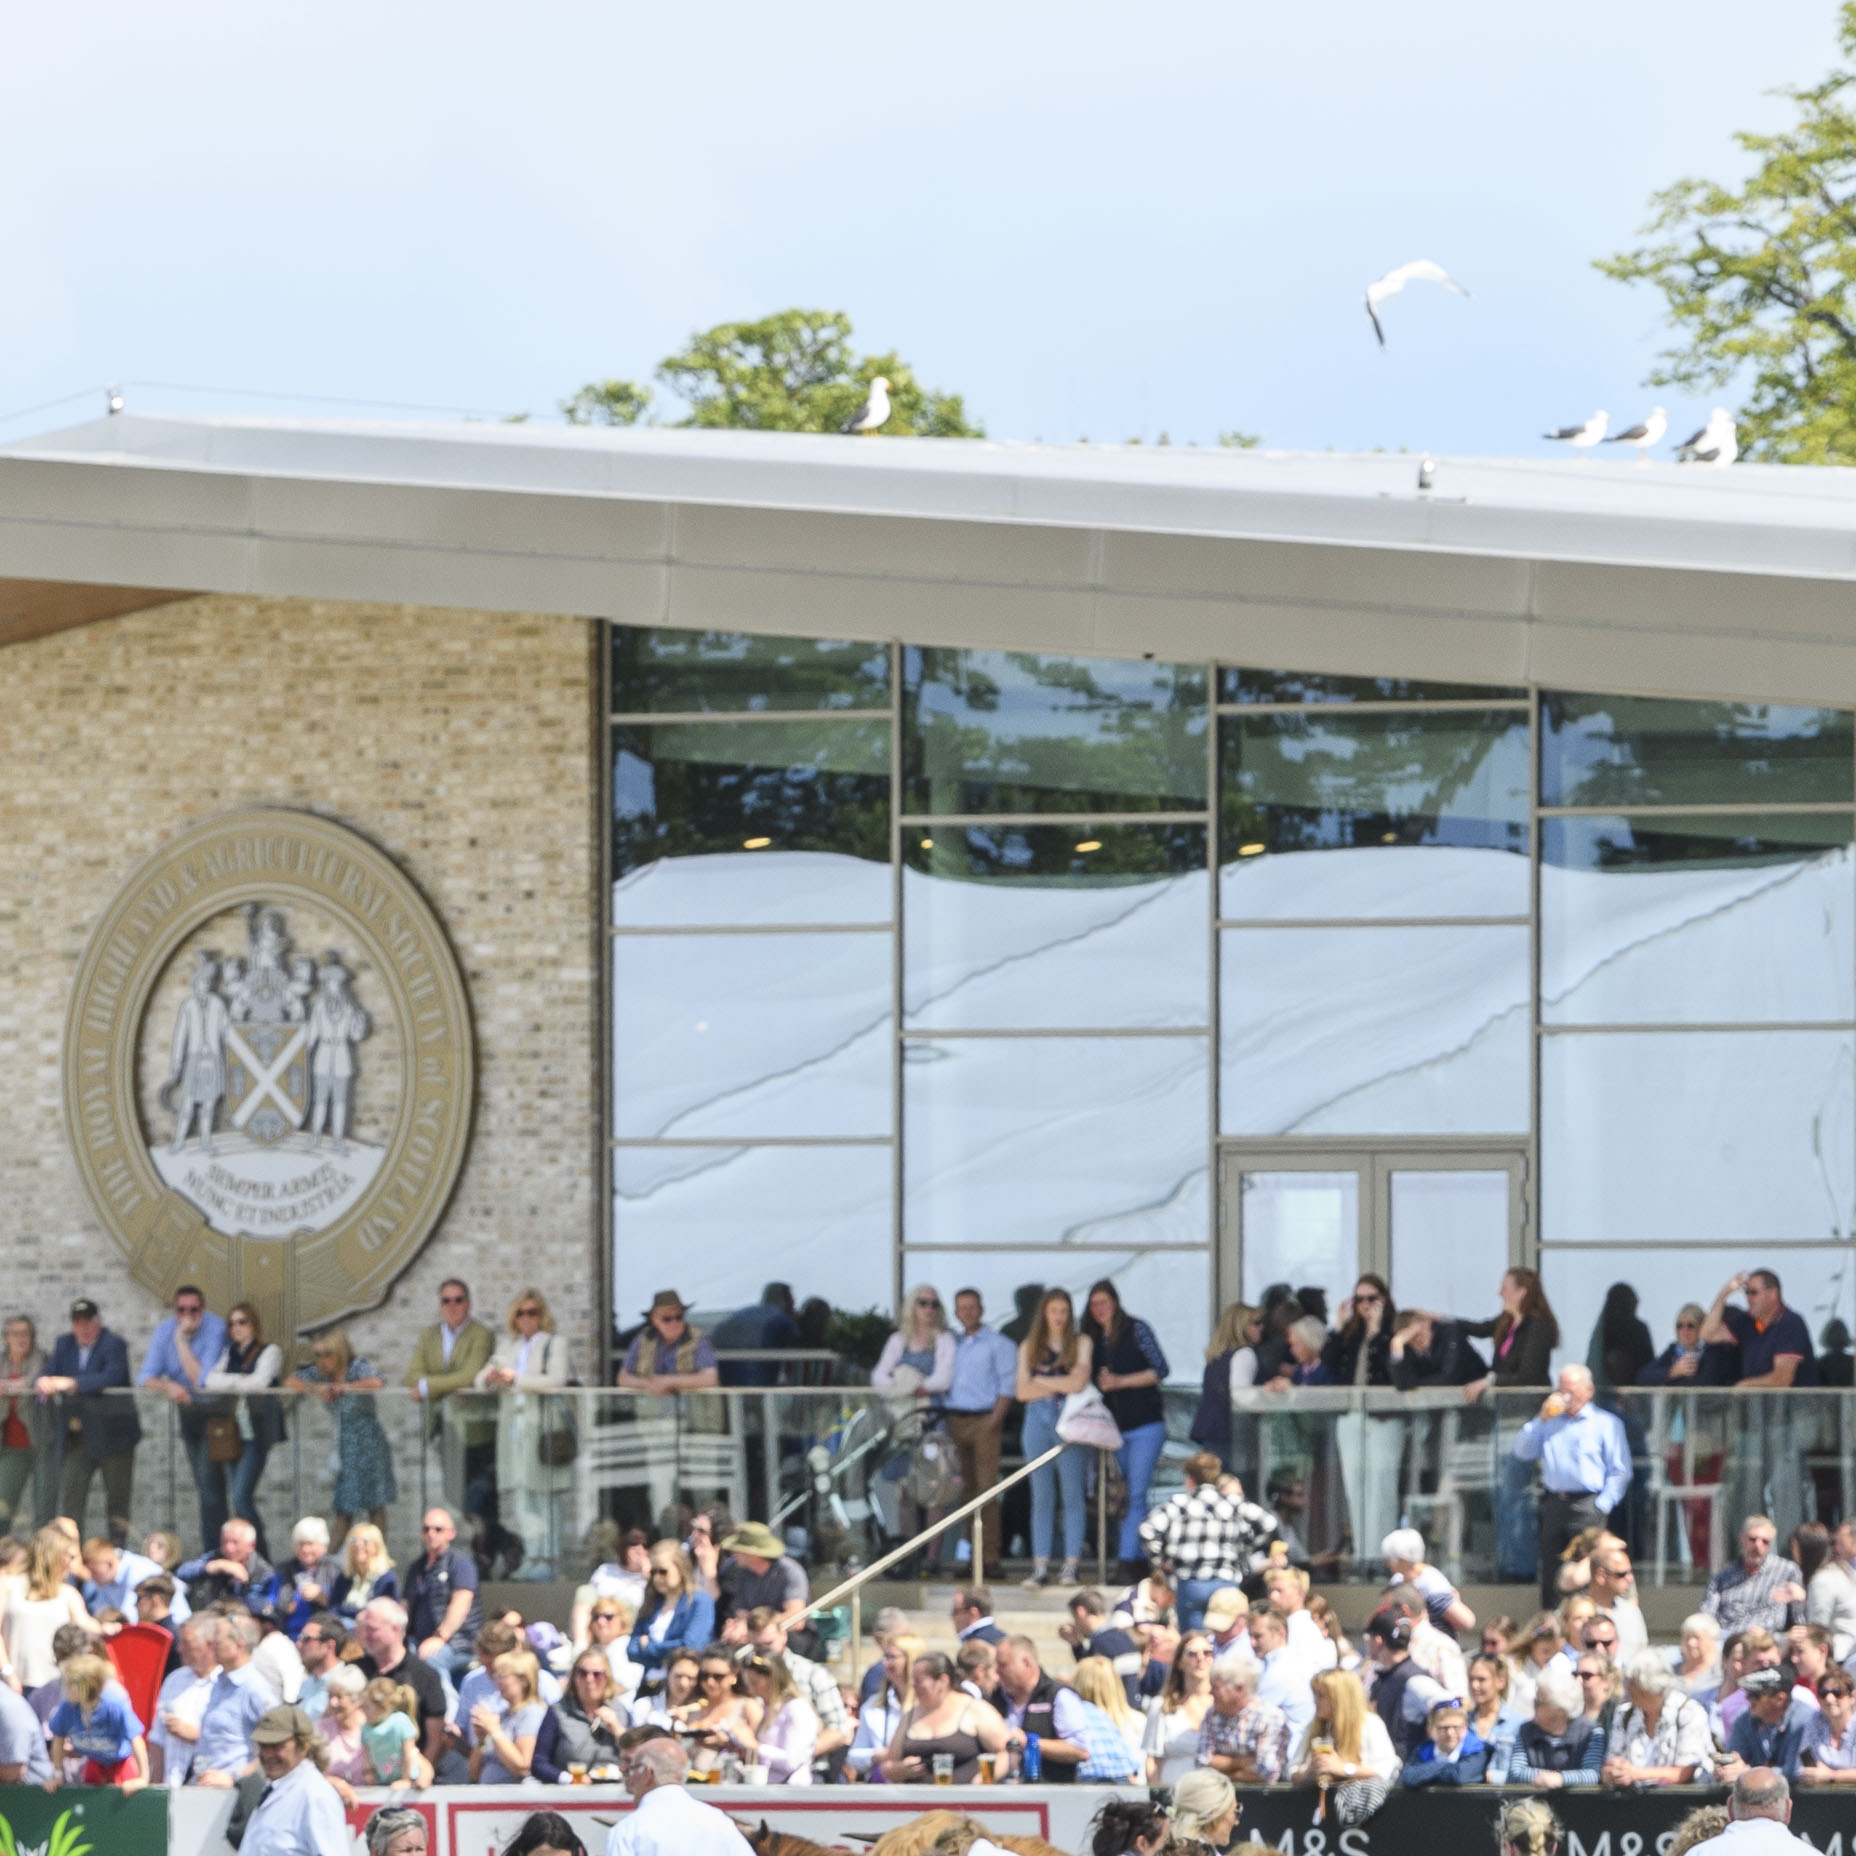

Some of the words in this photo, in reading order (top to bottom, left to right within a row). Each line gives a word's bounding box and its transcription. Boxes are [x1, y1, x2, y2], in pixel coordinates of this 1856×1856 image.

[204, 836, 389, 918] AGRICULTURAL
[89, 887, 178, 1031] HIGHLAND
[388, 916, 447, 1043] SOCIETY
[84, 1047, 117, 1153] ROYAL
[355, 1100, 445, 1252] SCOTLAND
